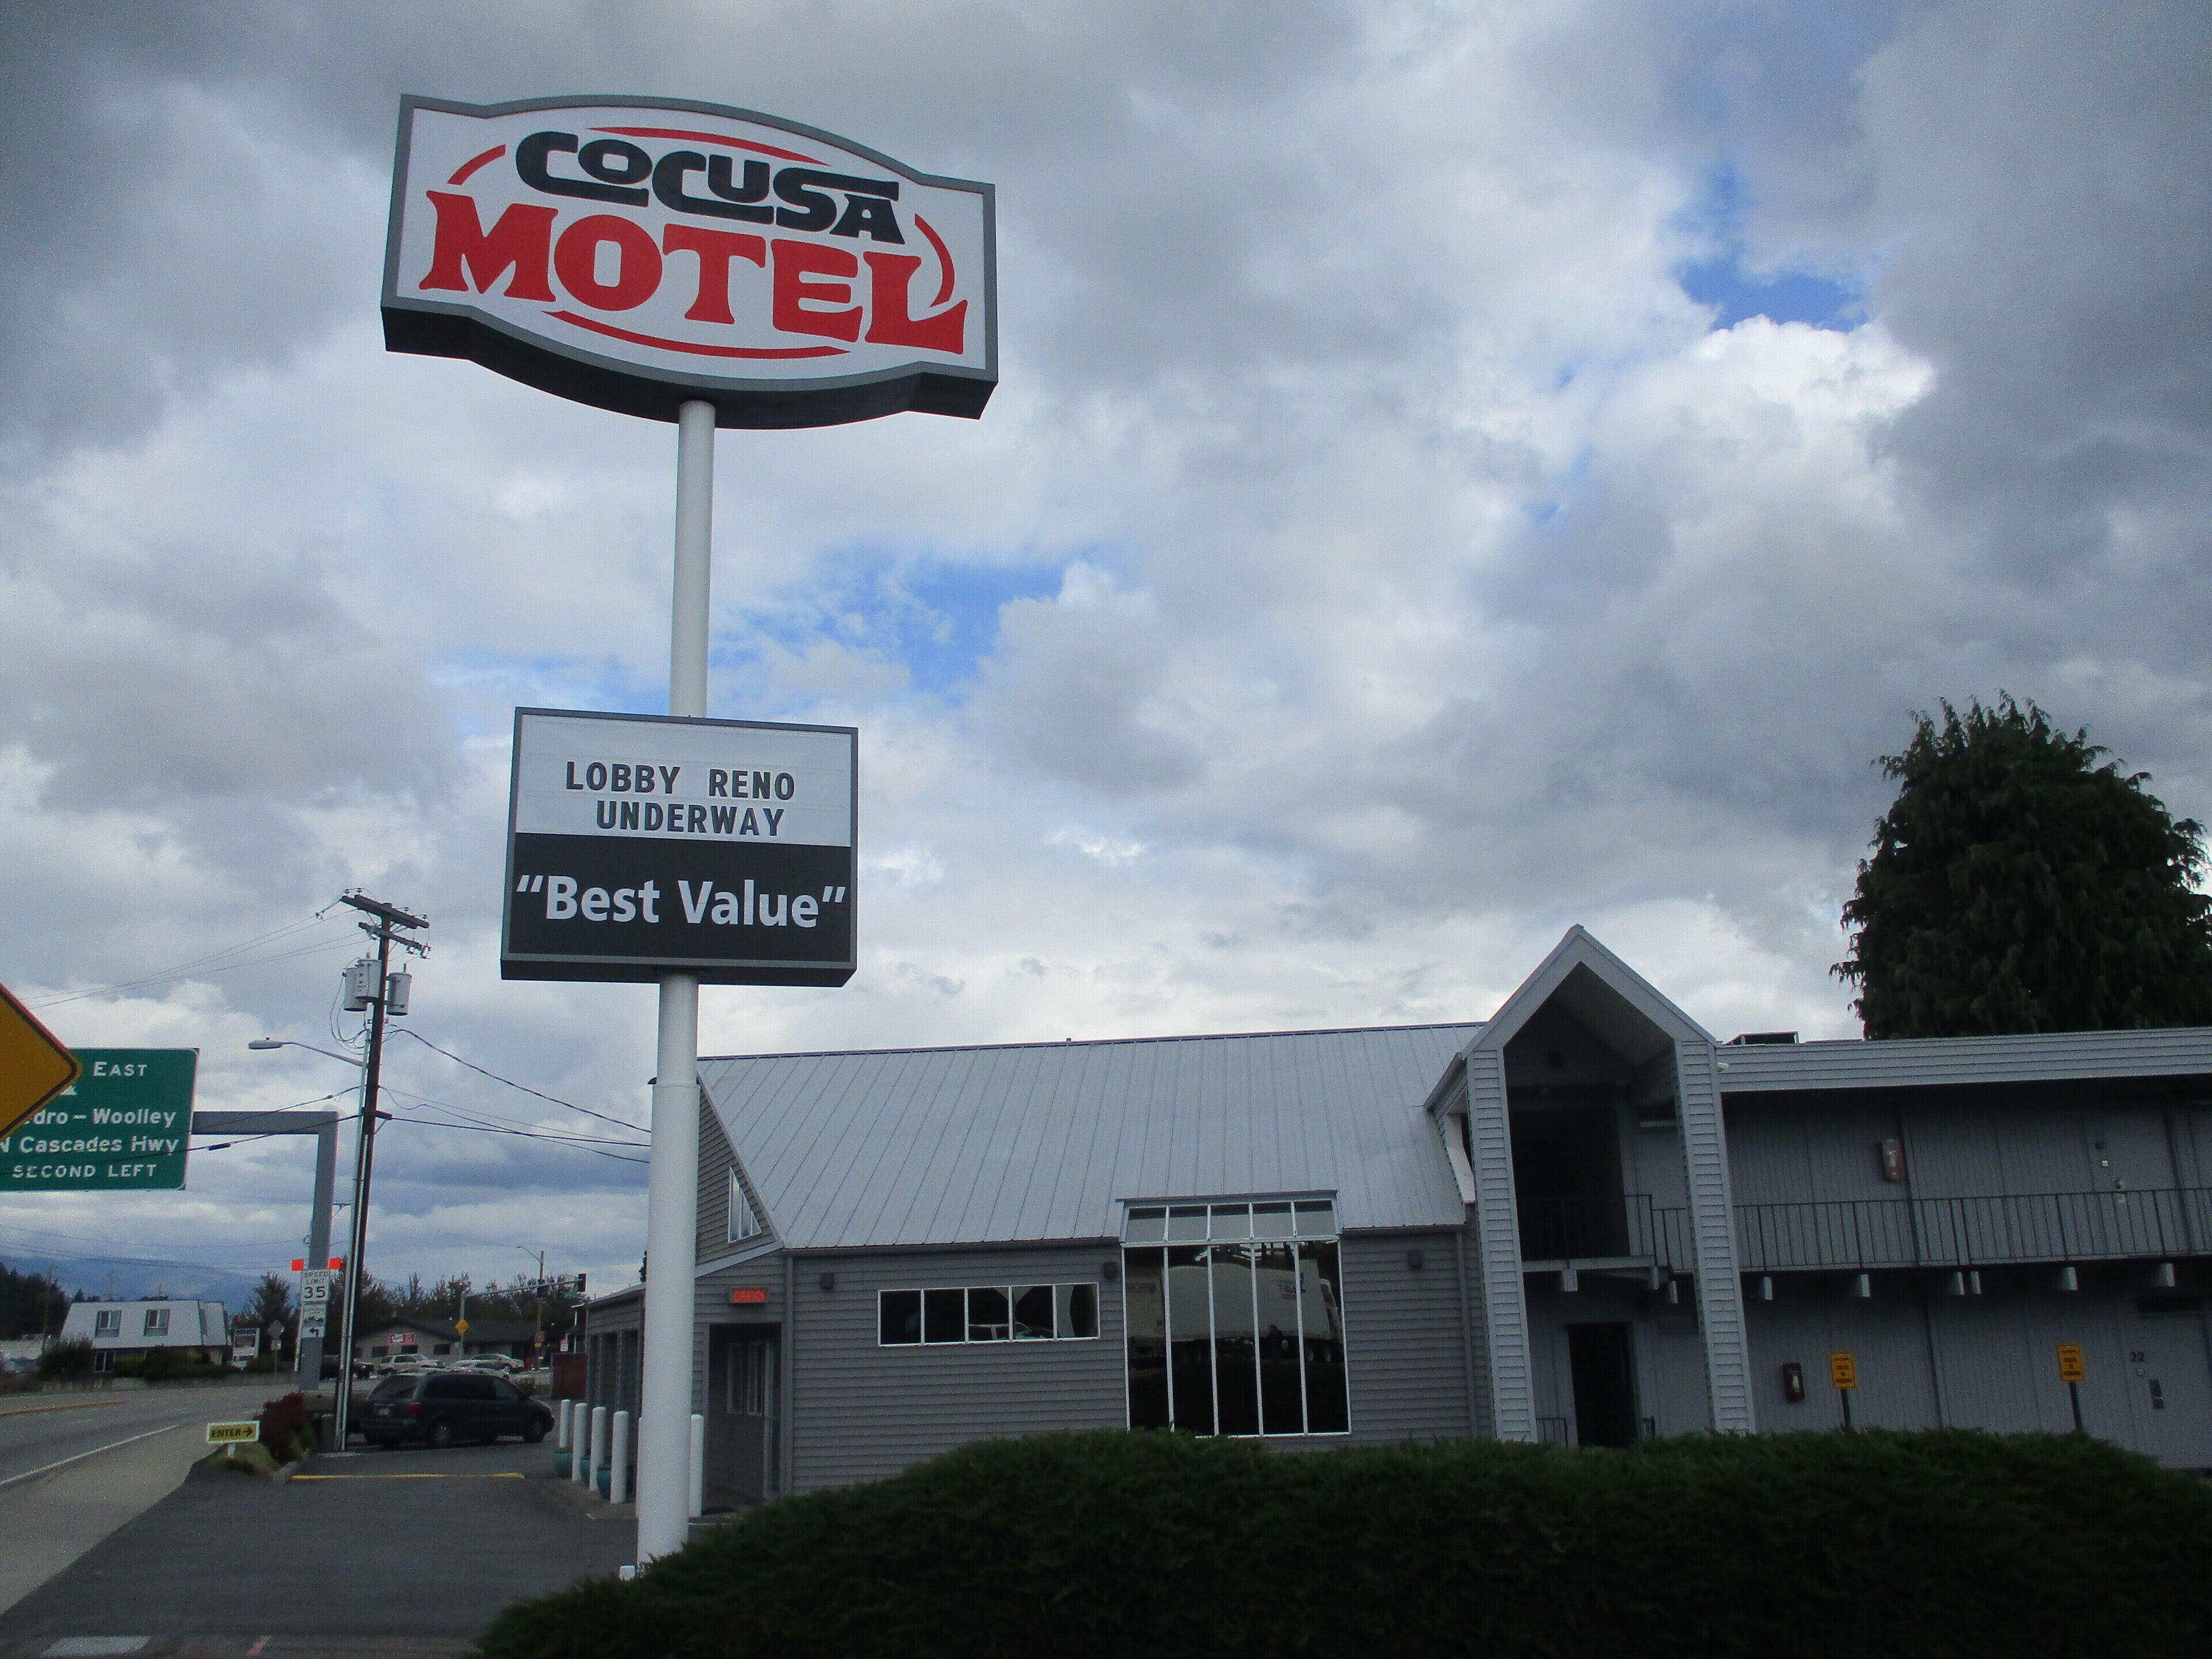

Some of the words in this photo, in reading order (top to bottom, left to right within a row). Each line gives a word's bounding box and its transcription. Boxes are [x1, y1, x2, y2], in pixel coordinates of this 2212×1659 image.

[516, 131, 905, 245] COCUSA
[419, 190, 967, 355] MOTEL
[566, 762, 680, 794] LOBBY
[709, 769, 795, 800] RENO
[597, 800, 785, 836] UNDERWAY
[93, 1061, 147, 1077] EAST
[19, 1136, 123, 1153] Cascades
[131, 1136, 179, 1156] Hwy
[12, 1164, 96, 1178] SECOND
[108, 1164, 157, 1177] LEFT
[304, 1286, 326, 1298] 35
[211, 1428, 241, 1437] ENTER
